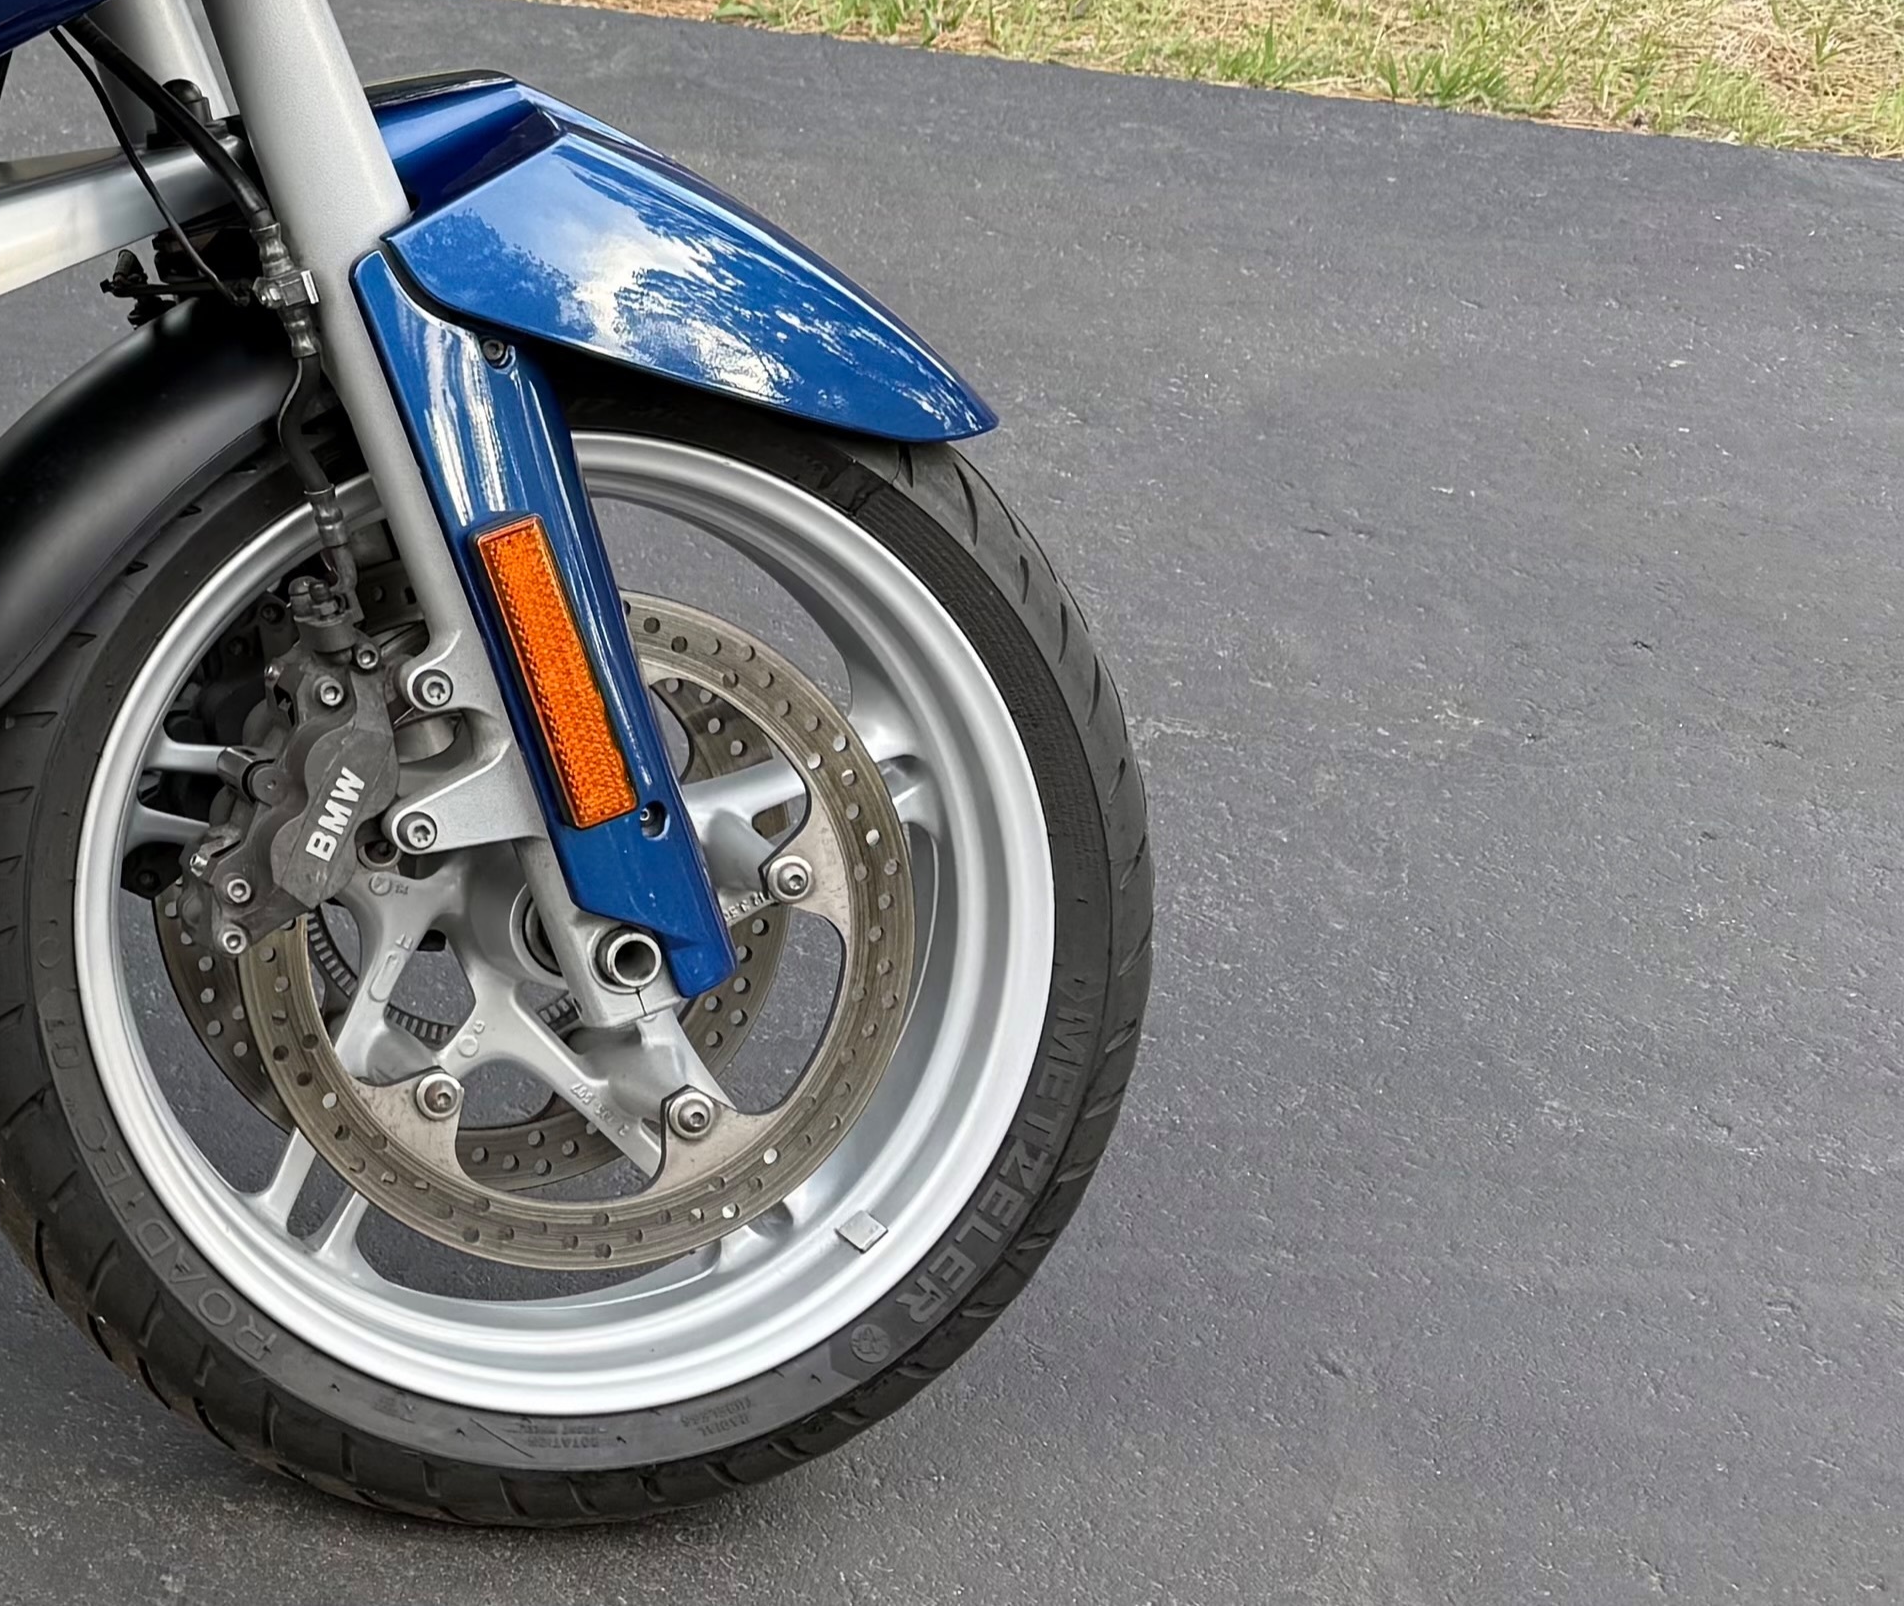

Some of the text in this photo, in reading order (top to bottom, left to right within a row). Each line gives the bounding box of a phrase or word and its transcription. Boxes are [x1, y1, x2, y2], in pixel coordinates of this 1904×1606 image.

[305, 767, 366, 862] BMW
[76, 1110, 278, 1362] ROADTEC
[895, 1009, 1097, 1326] METZELER
